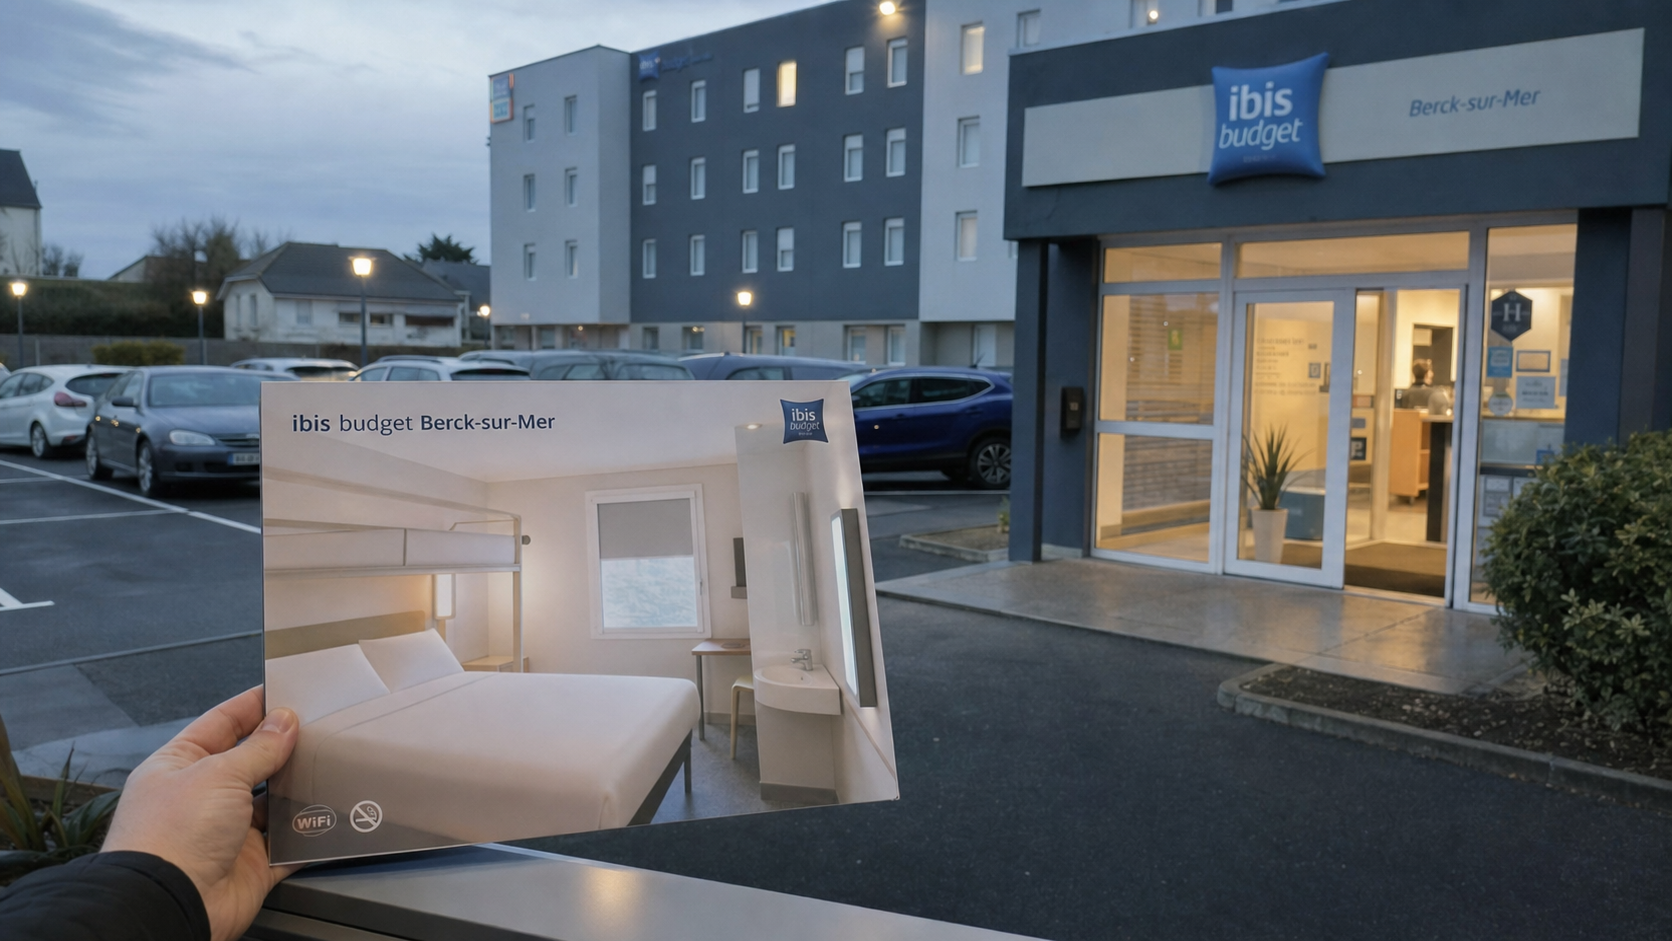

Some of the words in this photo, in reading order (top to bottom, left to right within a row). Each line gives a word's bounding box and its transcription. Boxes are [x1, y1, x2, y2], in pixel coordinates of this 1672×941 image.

[1229, 81, 1294, 121] ibis
[1409, 88, 1541, 118] Berck-sur-Mer
[1219, 118, 1304, 151] budget
[1503, 302, 1522, 322] H
[292, 414, 331, 432] ibis
[339, 414, 414, 436] budget
[420, 413, 556, 431] Berck-sur-Mer
[791, 408, 816, 422] ibis
[790, 421, 820, 432] budget
[297, 814, 331, 830] WiFi
